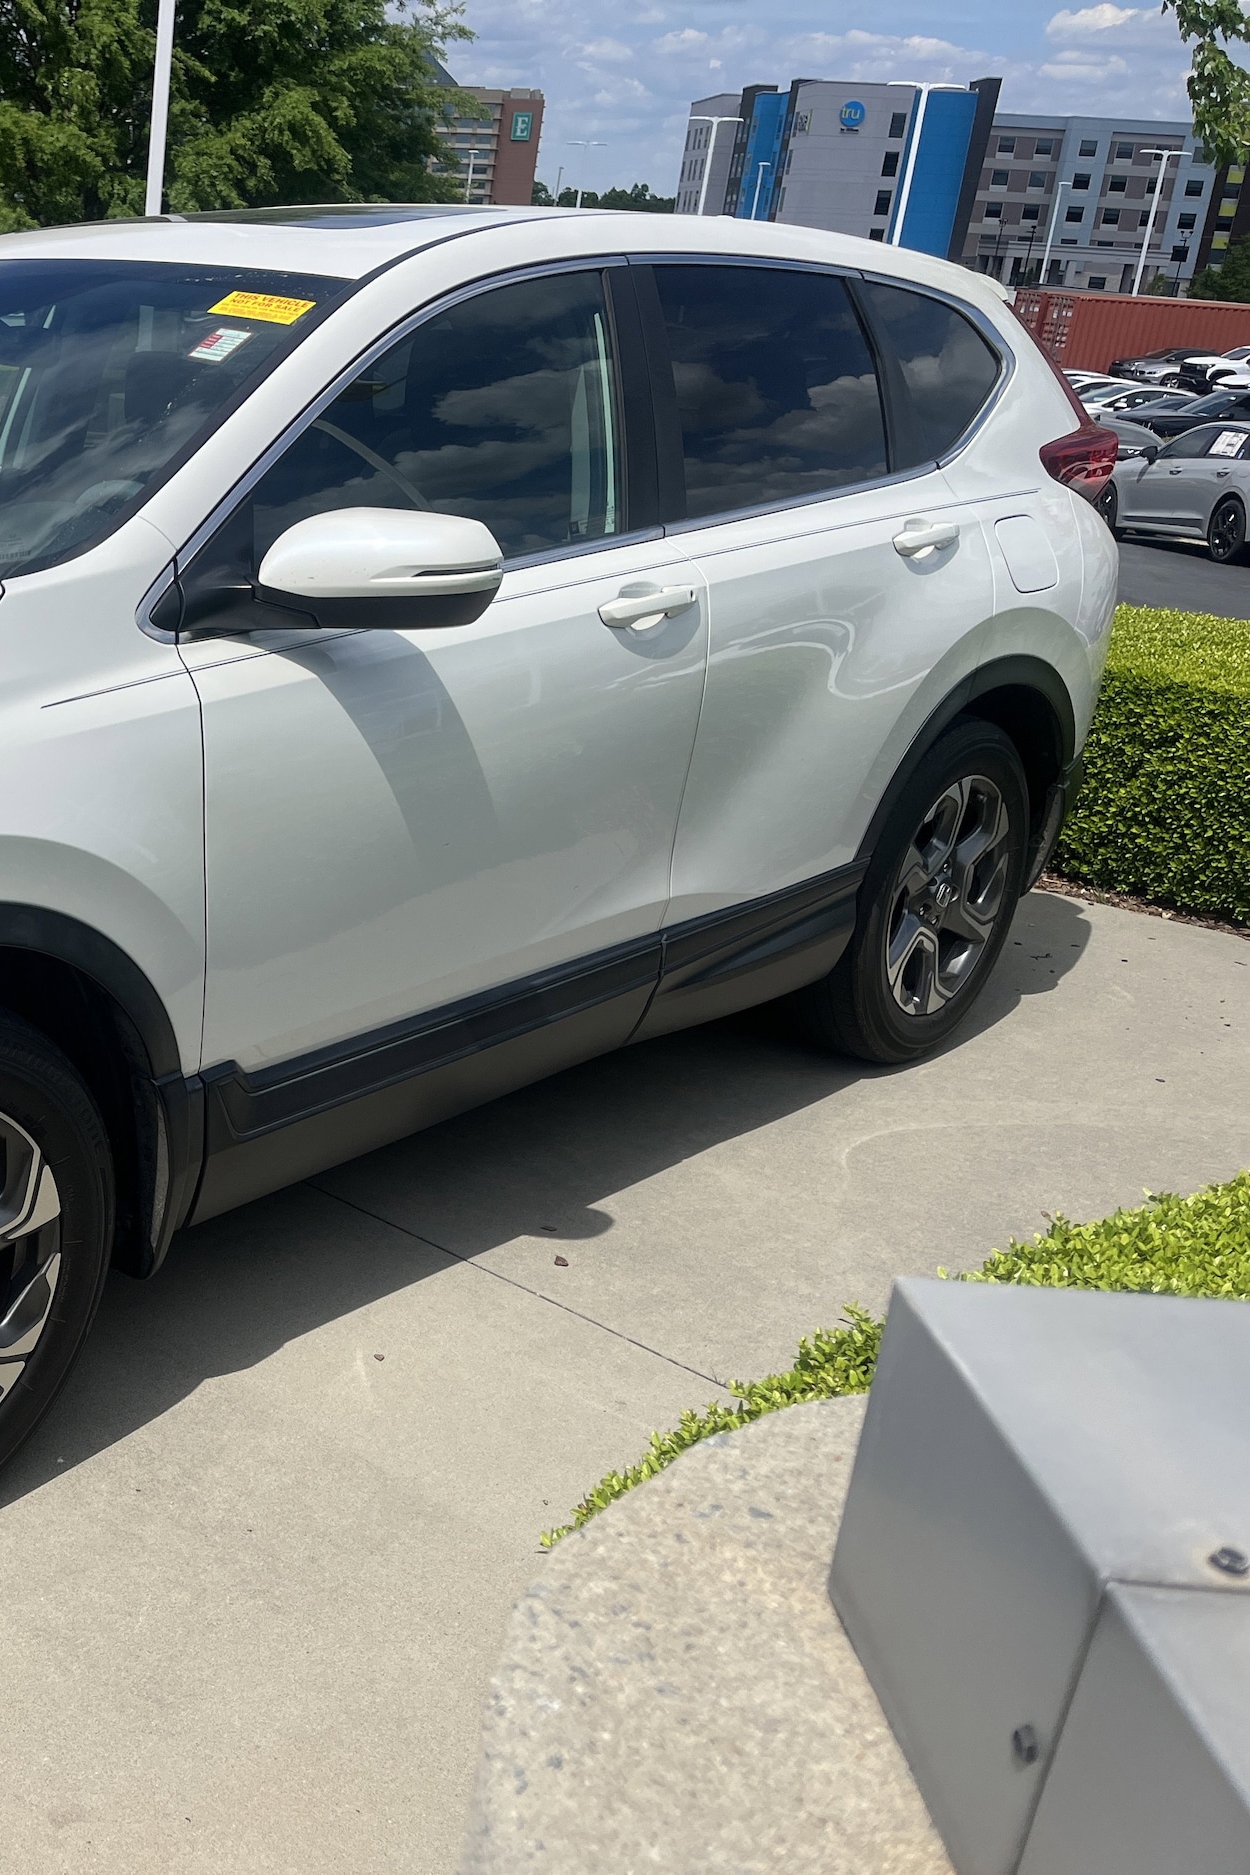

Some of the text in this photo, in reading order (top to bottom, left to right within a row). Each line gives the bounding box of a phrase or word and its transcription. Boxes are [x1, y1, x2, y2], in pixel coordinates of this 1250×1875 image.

[841, 106, 861, 120] tru
[515, 116, 529, 137] E
[234, 292, 261, 302] THIS
[261, 296, 310, 309] VEHICLE
[274, 304, 302, 313] SALE
